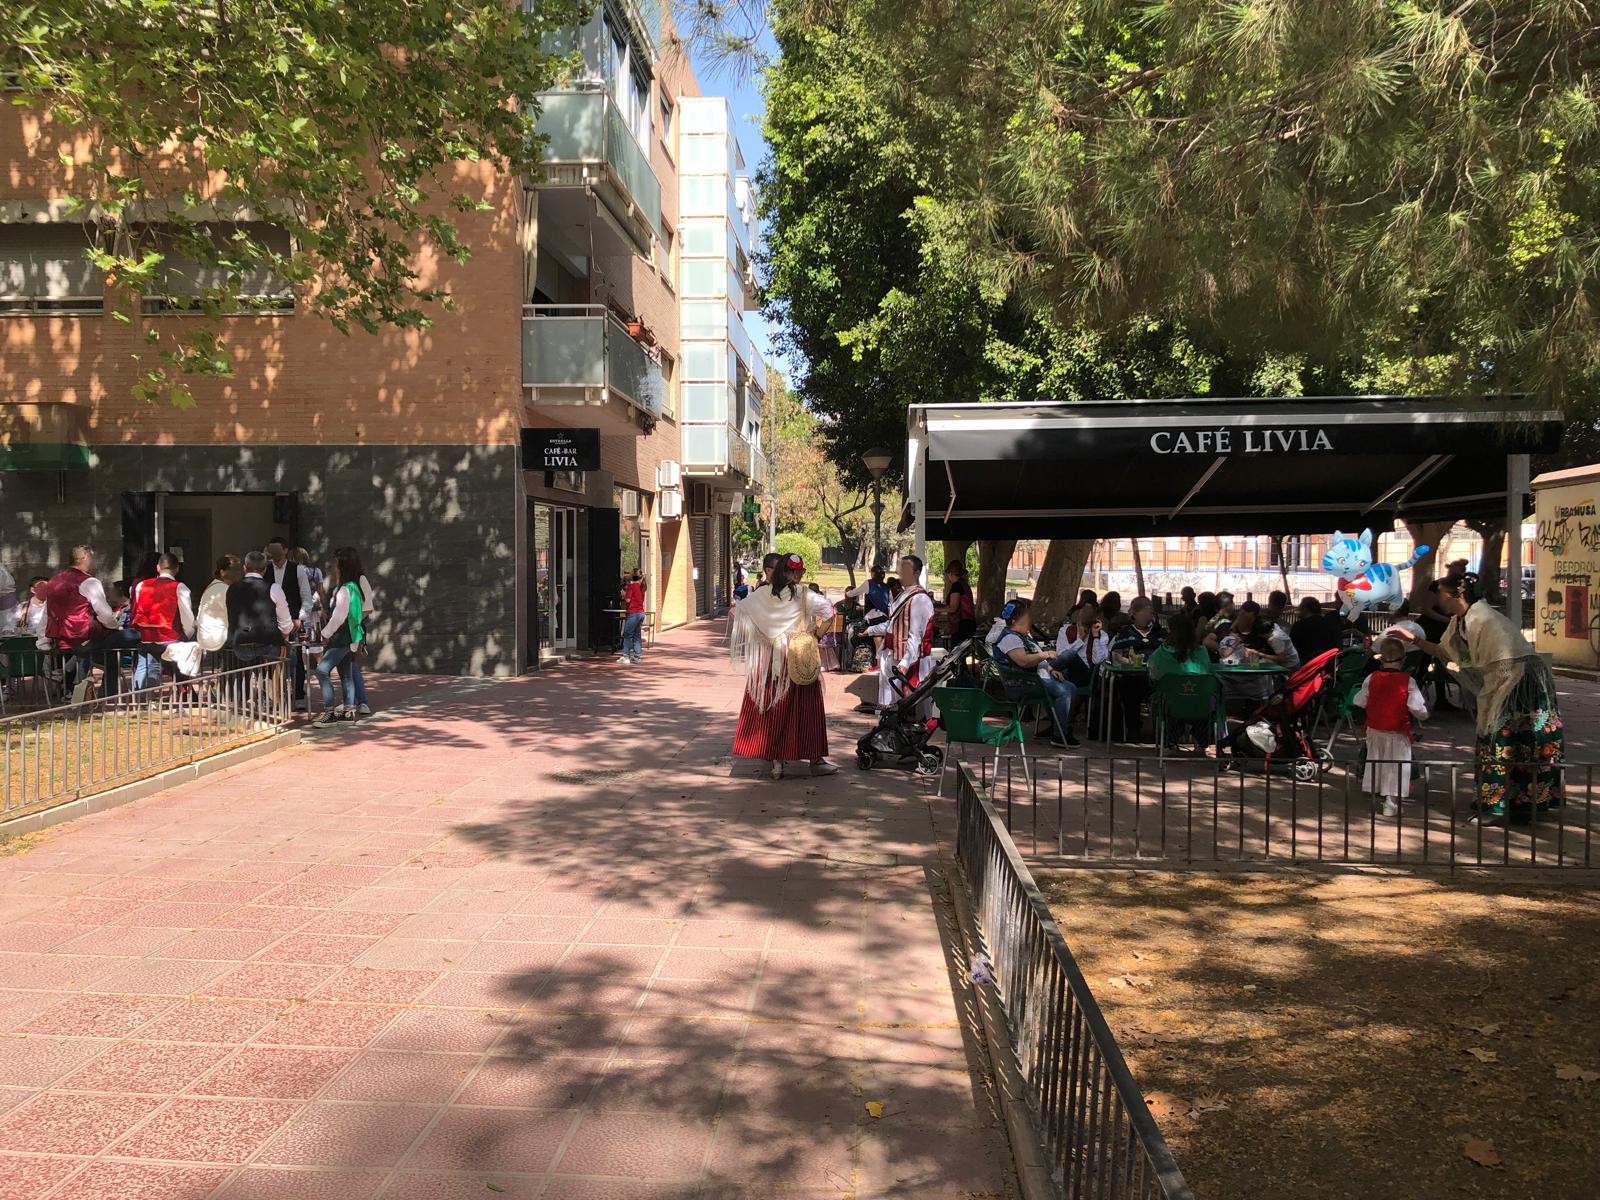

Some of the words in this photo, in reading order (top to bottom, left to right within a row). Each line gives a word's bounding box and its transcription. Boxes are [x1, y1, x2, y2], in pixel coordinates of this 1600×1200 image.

[1150, 427, 1232, 454] CAFÉ
[1243, 428, 1335, 453] LIVIA
[543, 456, 578, 467] LIVIA
[1554, 560, 1600, 573] IBERDROL
